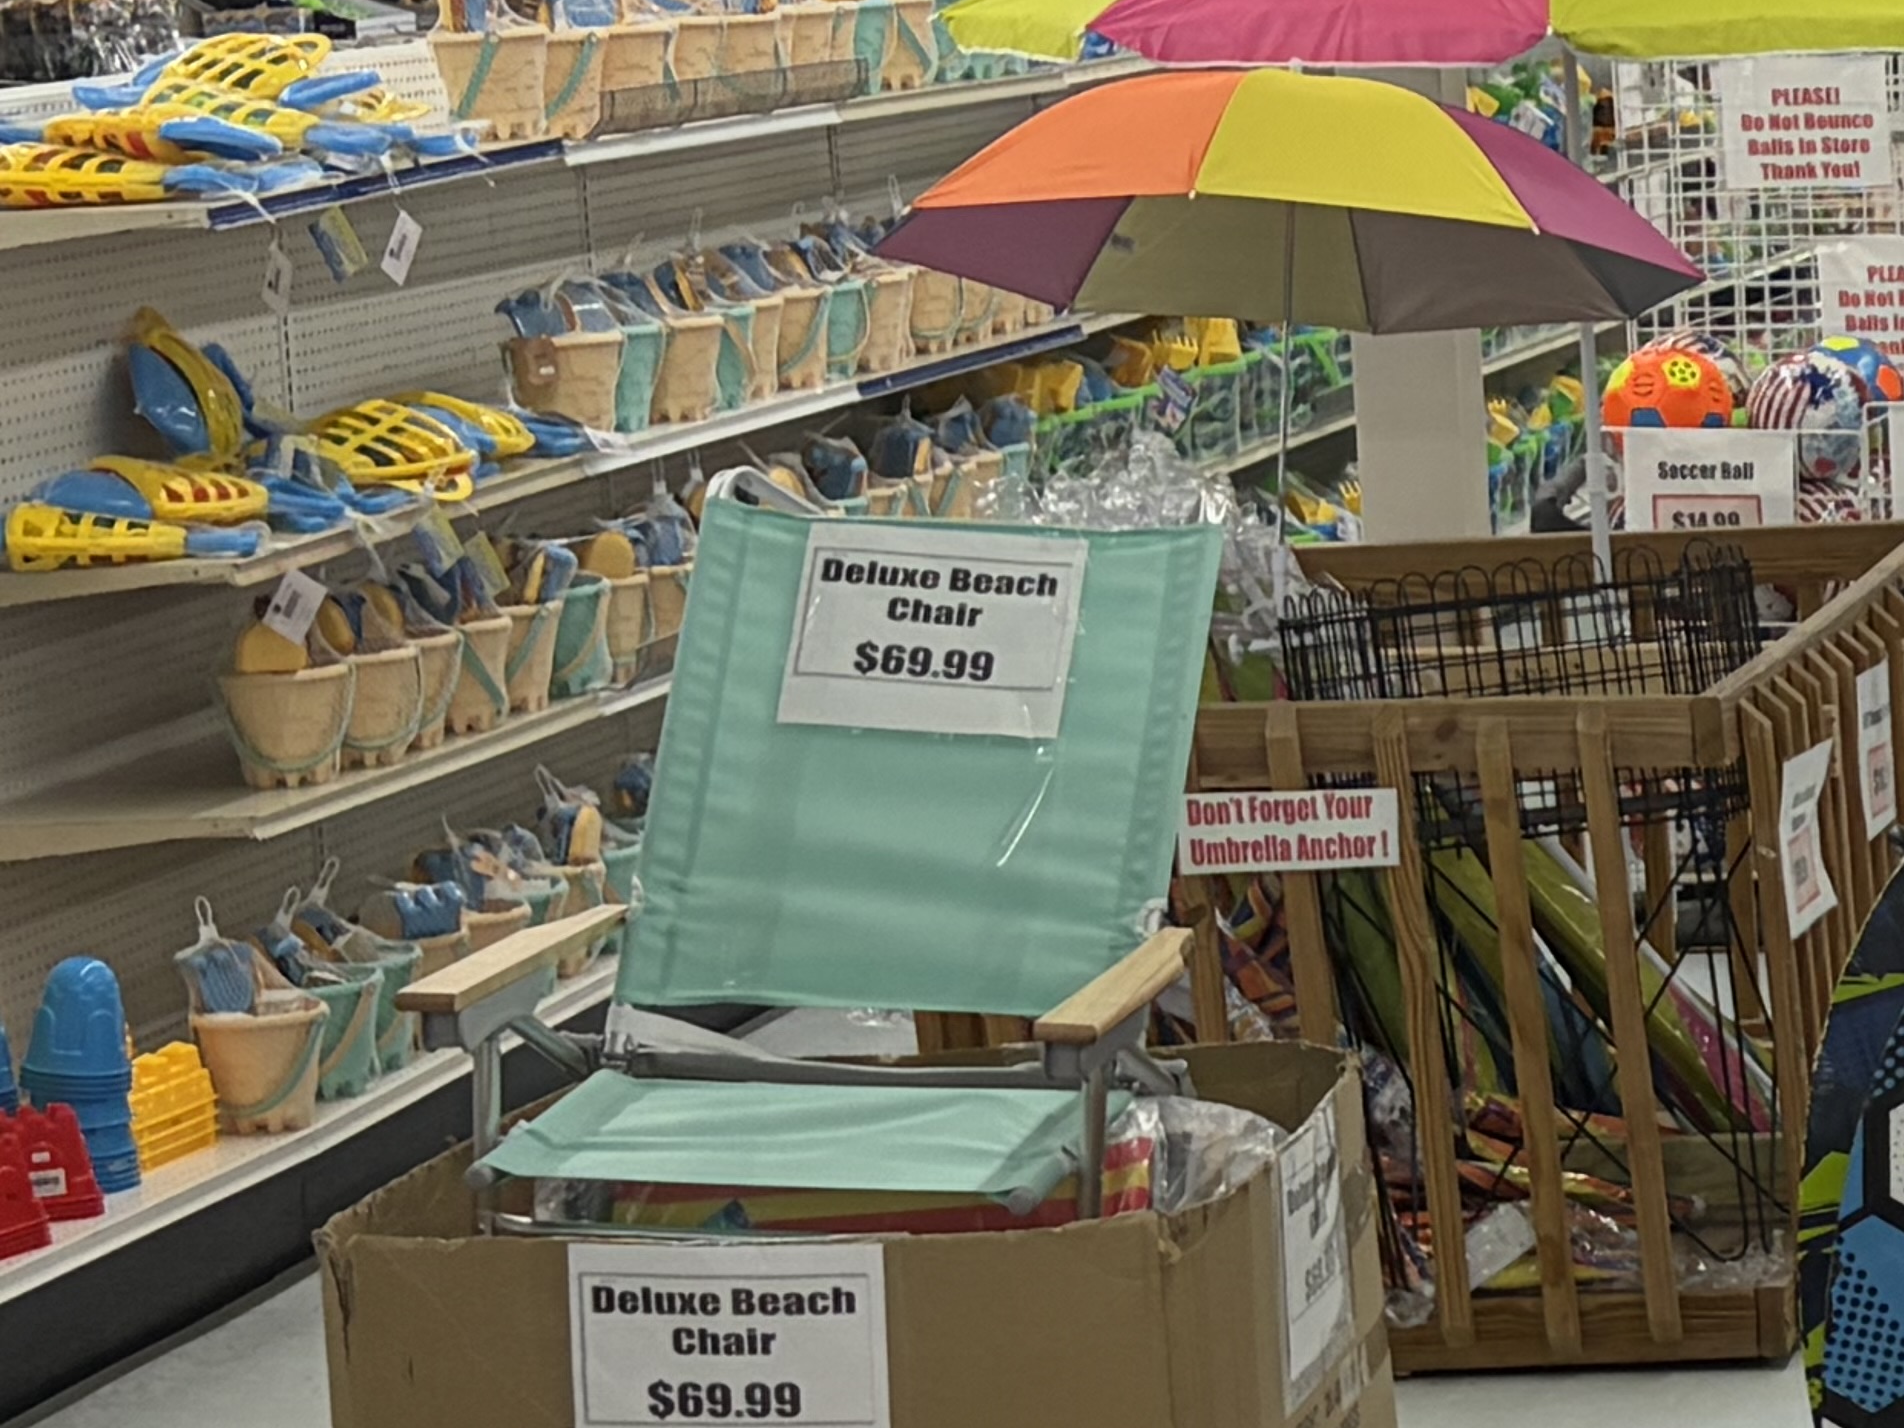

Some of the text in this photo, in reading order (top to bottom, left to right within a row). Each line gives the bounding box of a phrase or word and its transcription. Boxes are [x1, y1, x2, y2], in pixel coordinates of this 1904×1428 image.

[1771, 86, 1841, 107] PLEASE!
[1740, 112, 1875, 133] Do Not Bounce
[1748, 138, 1795, 157] Balls
[1821, 135, 1872, 155] Store
[1760, 160, 1861, 181] Thank You!
[1838, 290, 1862, 308] Do
[1864, 289, 1895, 307] Not
[1844, 314, 1890, 332] Balls
[1657, 461, 1755, 481] Soccer Ball
[1671, 510, 1741, 529] $1499
[820, 557, 1059, 598] Deluxe Beach
[886, 596, 984, 628] Chair
[853, 639, 995, 682] $69.99
[1186, 791, 1374, 827] Don't Forget Your
[1190, 834, 1293, 867] Umbrella
[1296, 831, 1377, 862] Anchor
[591, 1285, 857, 1317] Deluxe Beach
[671, 1326, 777, 1357] Chair
[647, 1378, 802, 1421] $69.99
